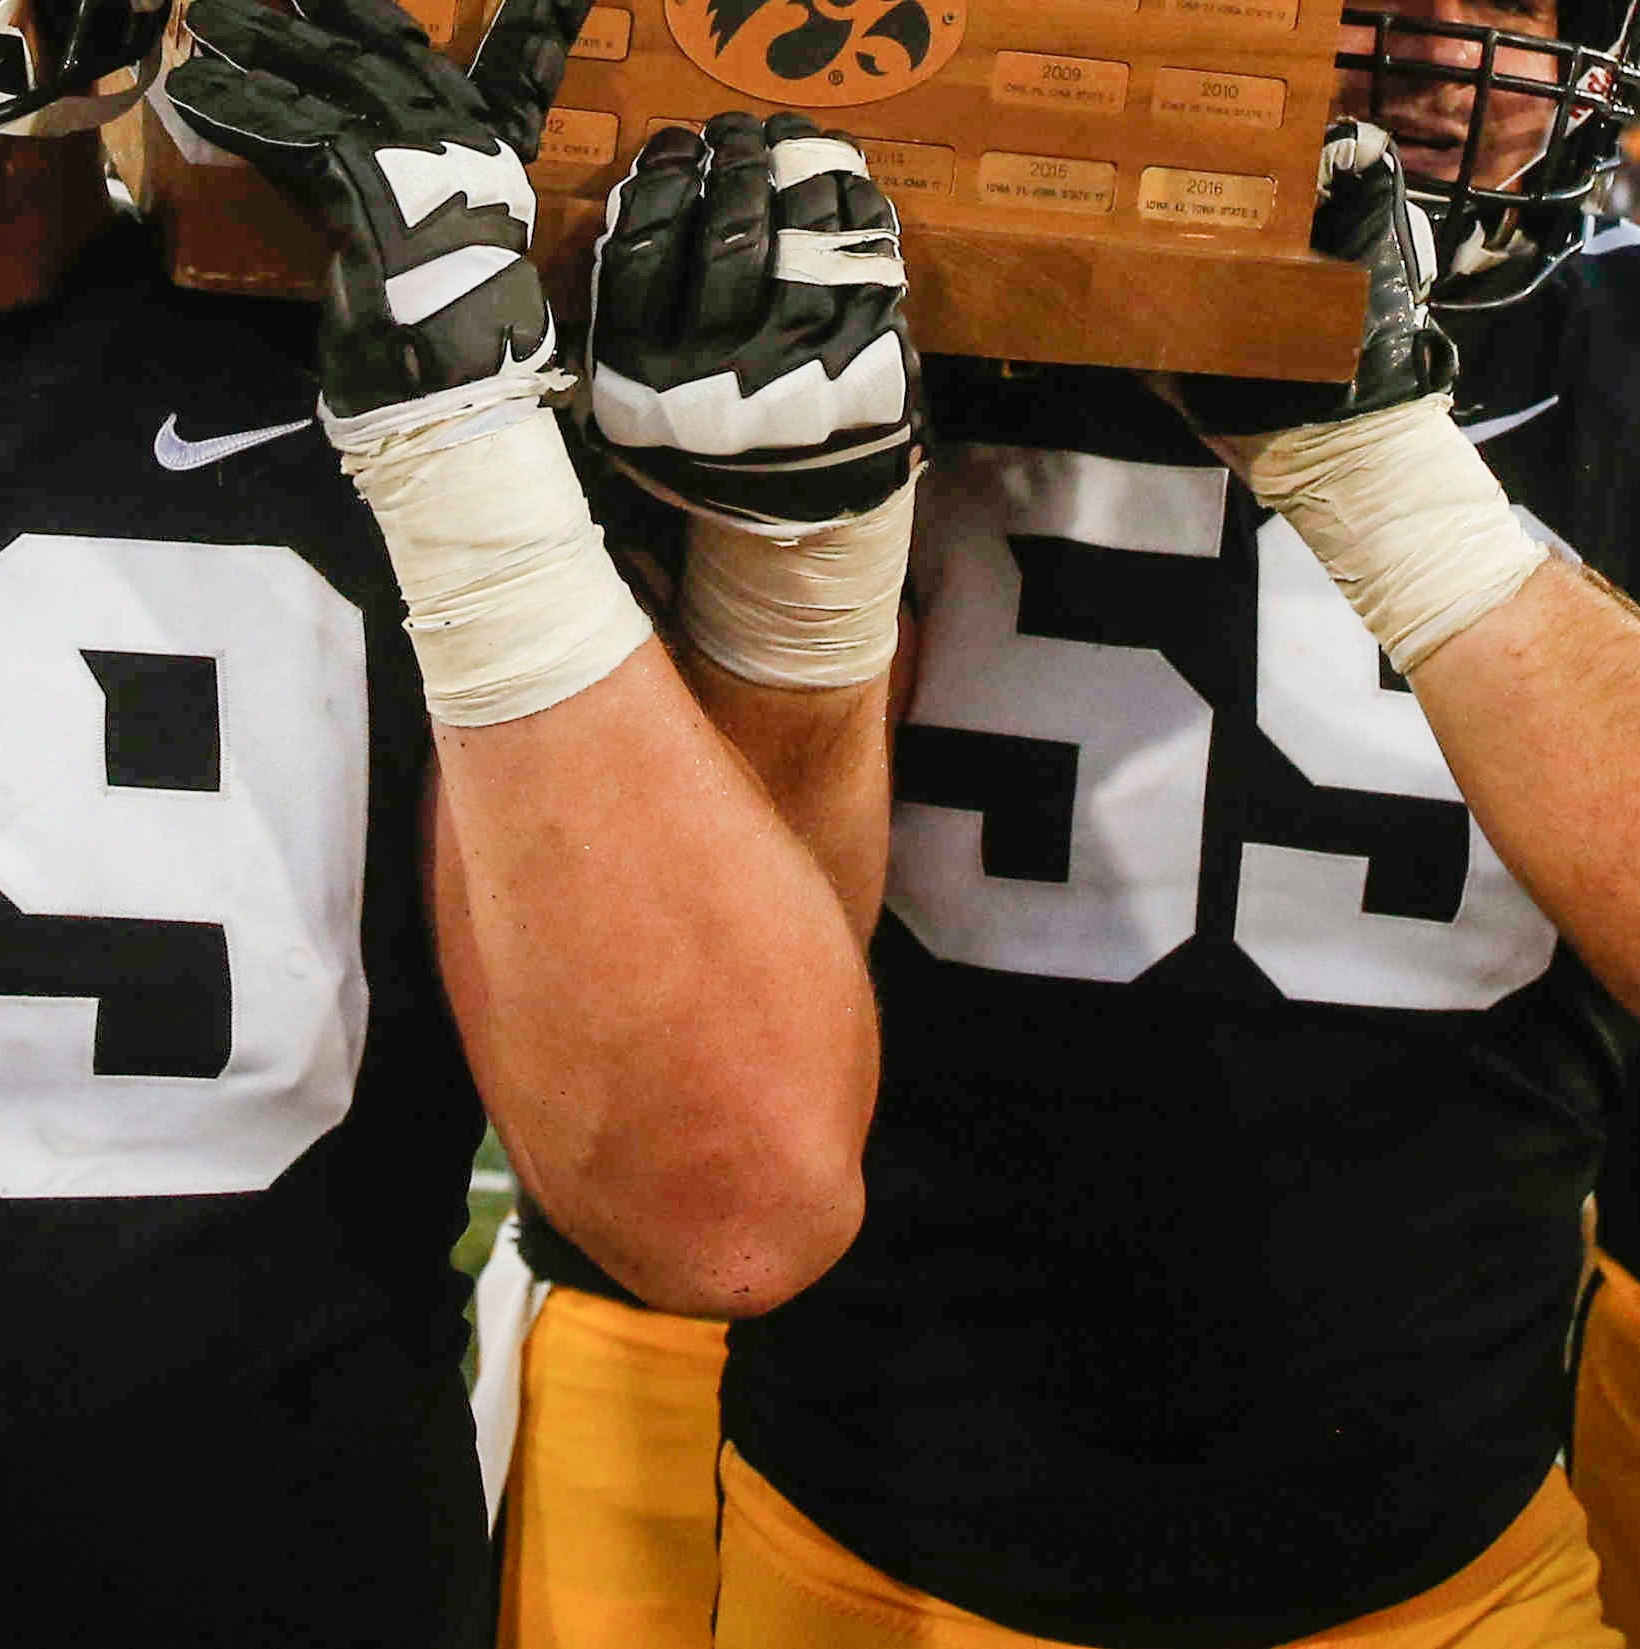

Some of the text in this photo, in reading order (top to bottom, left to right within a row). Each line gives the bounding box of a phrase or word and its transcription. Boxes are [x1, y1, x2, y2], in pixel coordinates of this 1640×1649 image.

[1041, 64, 1082, 84] 2009
[1200, 81, 1240, 100] 2010
[1029, 160, 1069, 180] 2015
[1185, 178, 1224, 197] 2016
[882, 442, 1581, 1012] 59
